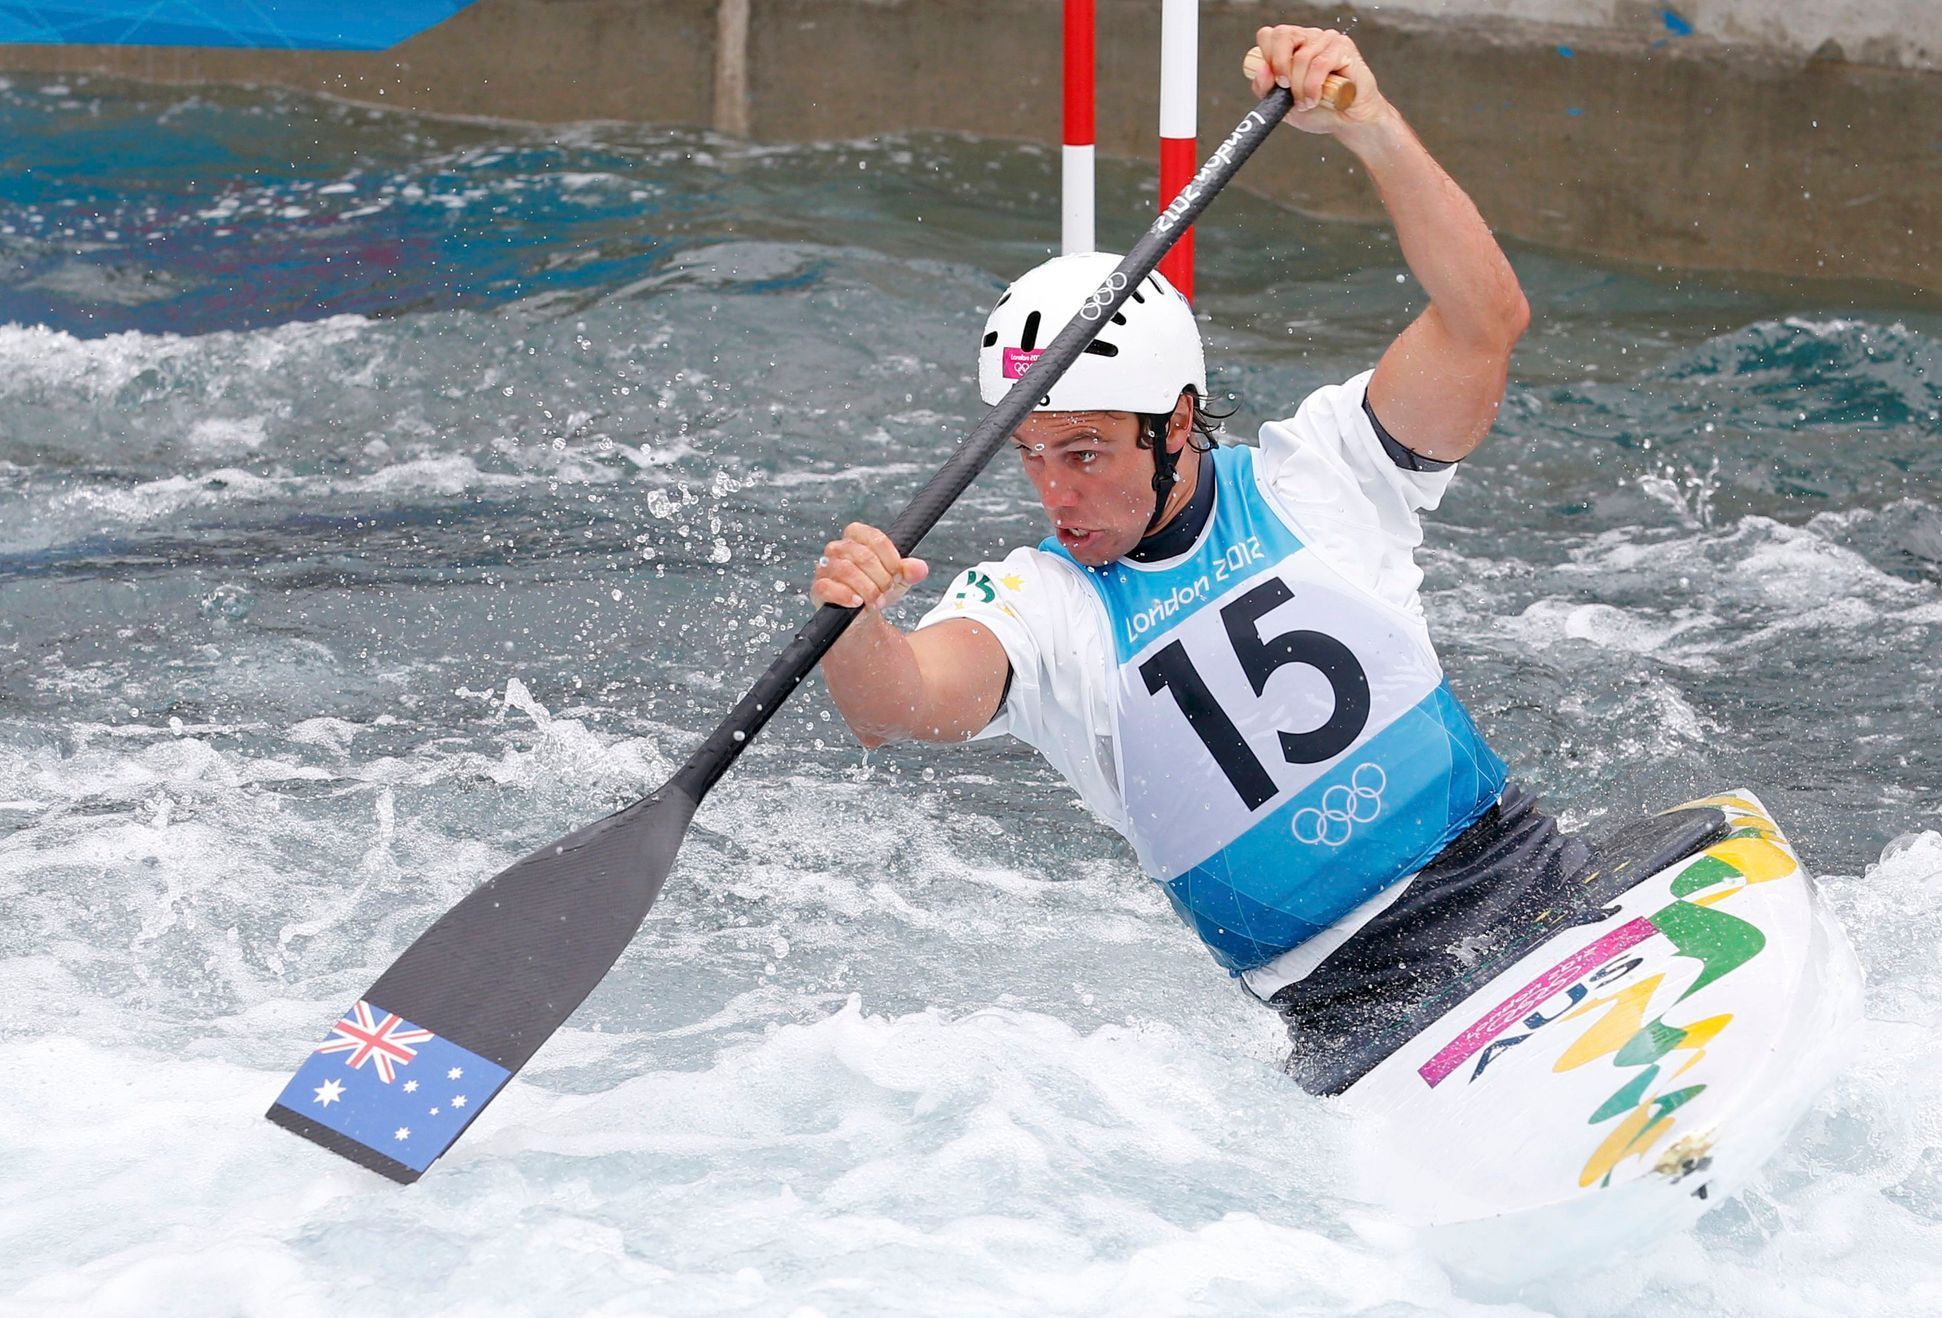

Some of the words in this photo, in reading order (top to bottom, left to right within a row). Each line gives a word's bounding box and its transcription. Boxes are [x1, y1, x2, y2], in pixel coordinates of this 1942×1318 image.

[1153, 183, 1201, 233] 2012
[1212, 535, 1265, 582] 2012
[1138, 576, 1371, 812] 15
[1548, 946, 1599, 981] 2012
[1467, 953, 1644, 1085] AUS
